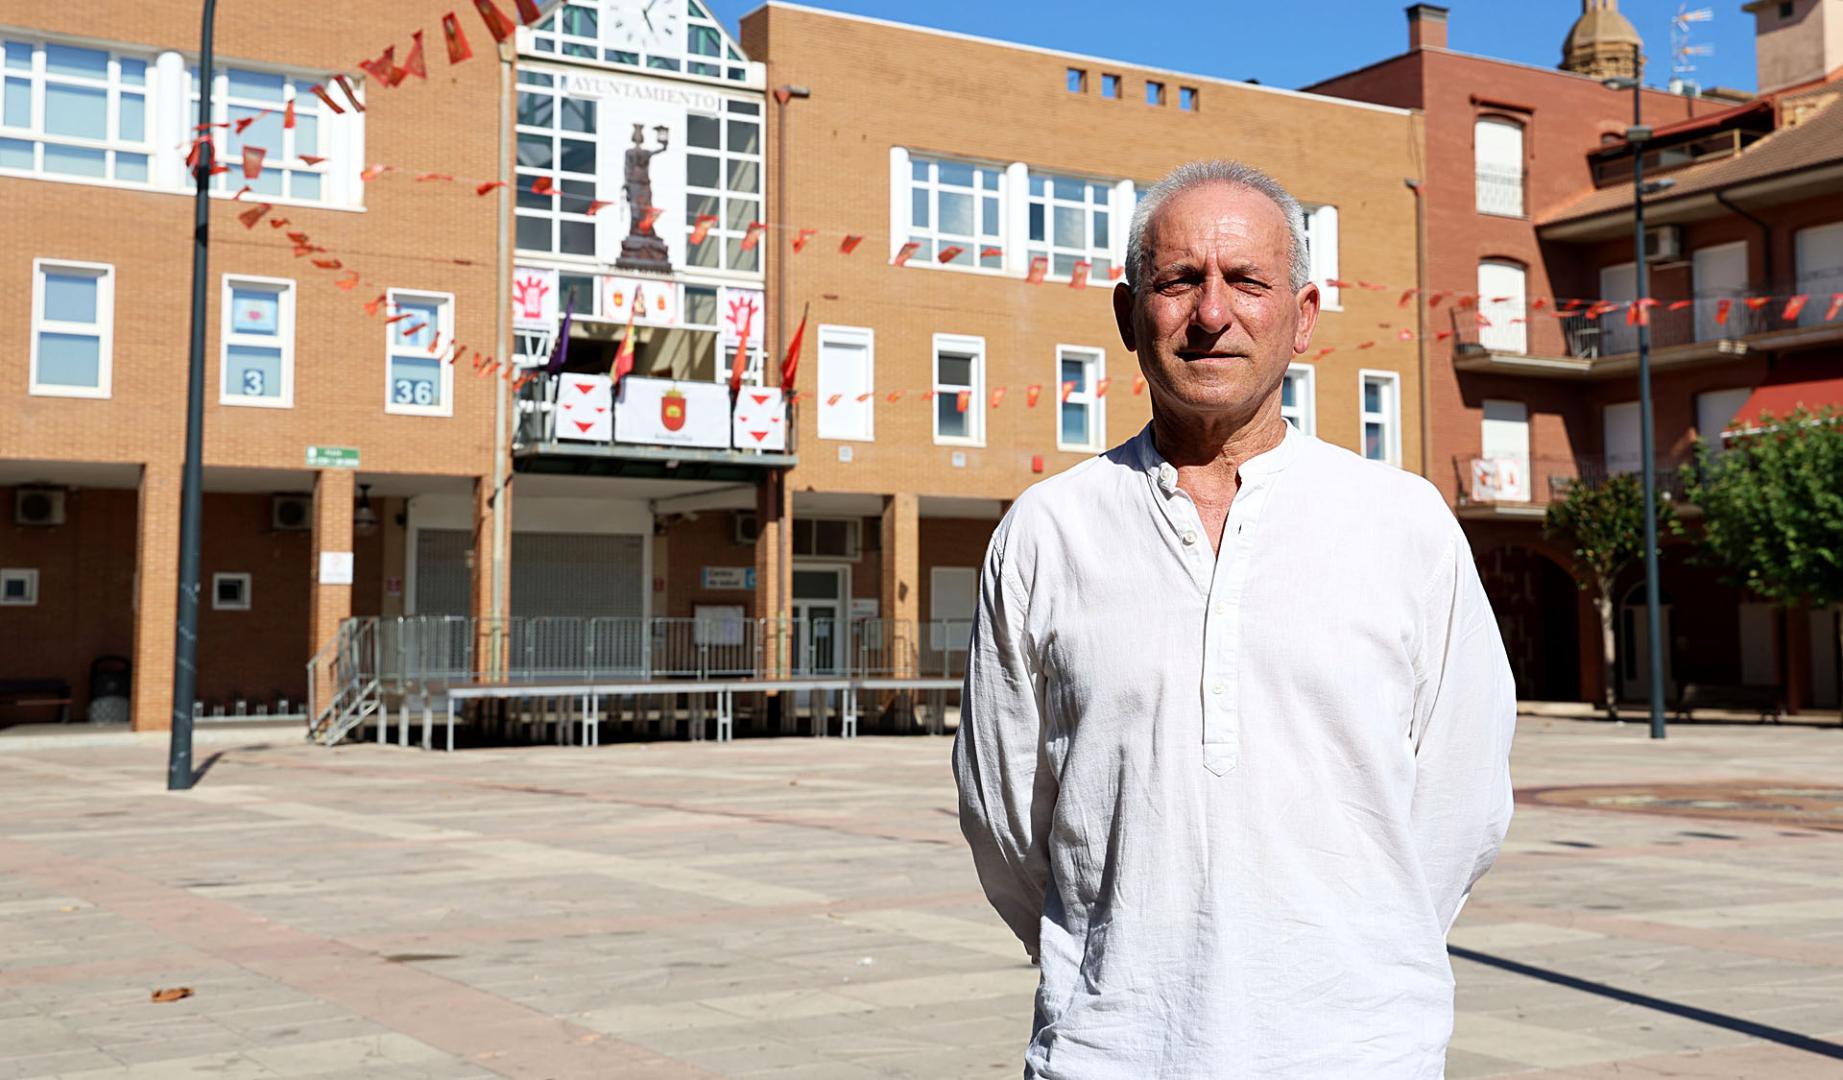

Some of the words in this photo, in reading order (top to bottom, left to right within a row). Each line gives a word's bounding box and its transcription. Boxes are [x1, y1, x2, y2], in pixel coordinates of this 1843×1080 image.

[573, 75, 716, 109] AYUNTAMIENTO
[245, 370, 263, 396] 3
[395, 380, 433, 405] 36
